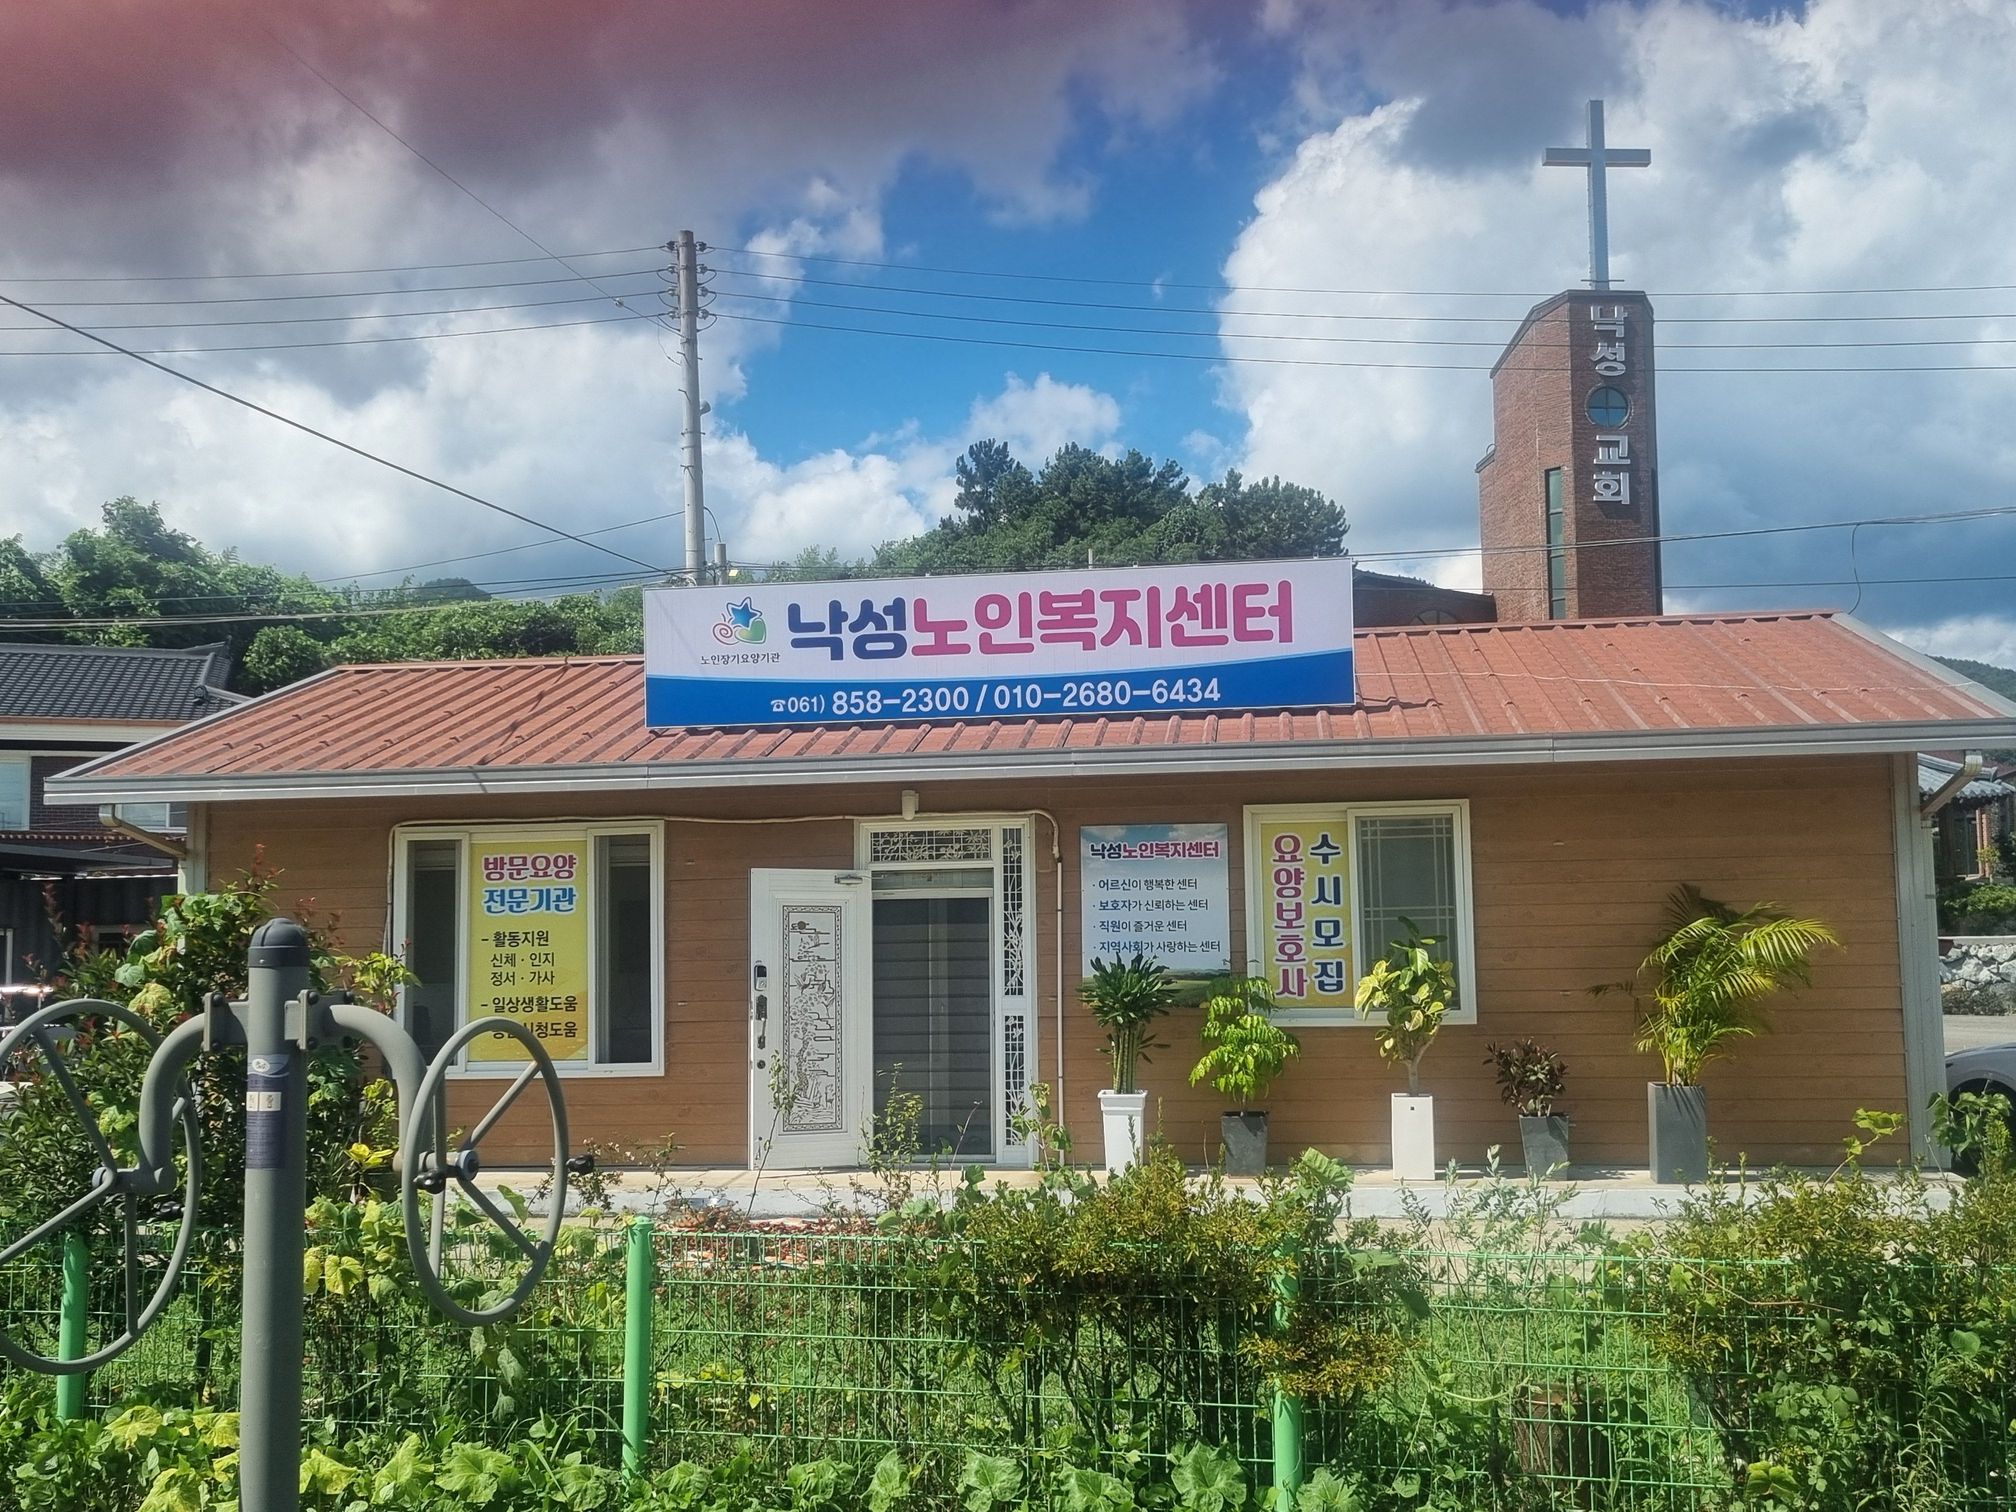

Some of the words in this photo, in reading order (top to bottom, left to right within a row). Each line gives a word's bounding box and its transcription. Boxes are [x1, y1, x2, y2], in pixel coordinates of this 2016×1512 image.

[1590, 305, 1628, 377] 낙성
[1593, 434, 1631, 505] 교회
[787, 579, 1293, 661] 낙성노인복지센터
[701, 652, 781, 665] 노인장기요양기관
[831, 686, 970, 717] 858-2300
[994, 677, 1221, 710] 010-2680-6434
[1090, 841, 1219, 860] 낙성노인복지센터
[483, 854, 577, 882] 방문요양
[1098, 878, 1142, 891] 어르신이
[1143, 878, 1175, 891] 행복한
[1177, 878, 1198, 890] 센터
[483, 887, 577, 914] 전문기관
[1098, 899, 1142, 912] 보호자가
[1144, 899, 1186, 911] 신뢰하는
[1187, 898, 1208, 911] 센터
[1272, 834, 1308, 997] 요양보호사
[1310, 833, 1344, 993] 수시모집
[1099, 920, 1131, 933] 직원이
[1133, 920, 1165, 932] 즐거운
[1166, 919, 1187, 932] 센터
[492, 930, 549, 947] 활동지원
[1100, 940, 1155, 954] 지역사회가
[1156, 940, 1198, 953] 사랑하는
[1199, 940, 1221, 952] 센터
[490, 953, 517, 967] 신체
[529, 952, 555, 966] 인지
[490, 971, 516, 986] 정서
[529, 970, 555, 985] 가사
[492, 995, 578, 1013] 일상생활도움
